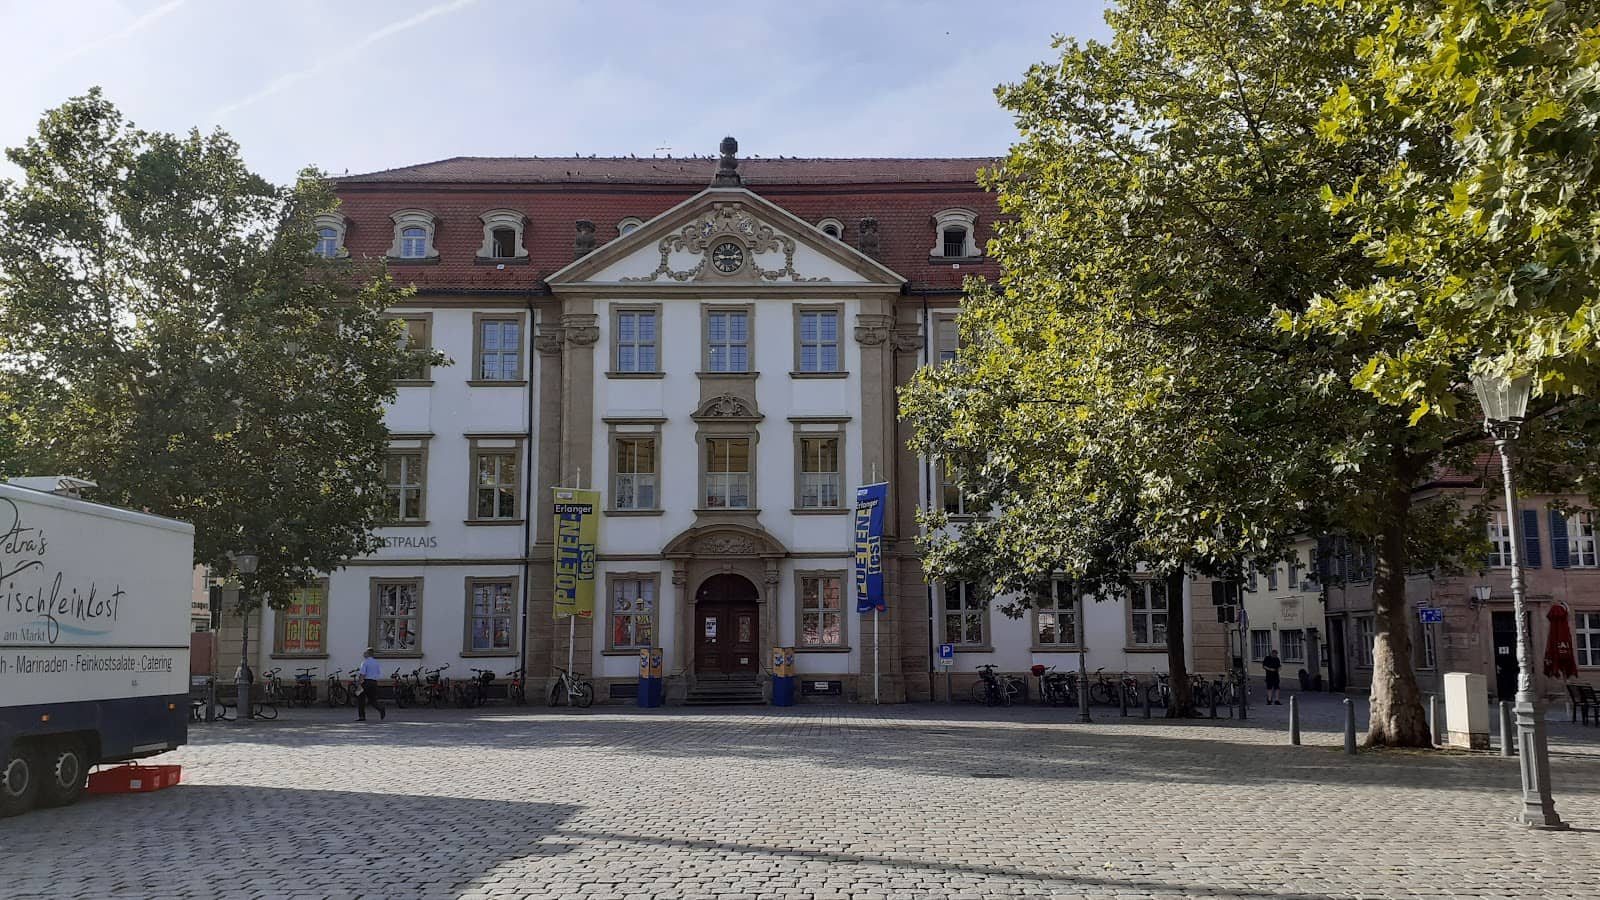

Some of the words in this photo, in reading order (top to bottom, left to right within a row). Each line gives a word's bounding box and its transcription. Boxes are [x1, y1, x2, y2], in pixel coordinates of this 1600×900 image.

[555, 504, 592, 514] Erlanger
[4, 630, 18, 641] am
[21, 628, 46, 641] Markt
[16, 655, 68, 674] Marinaden
[76, 654, 136, 672] Feinkostsalate
[141, 654, 172, 673] Catering
